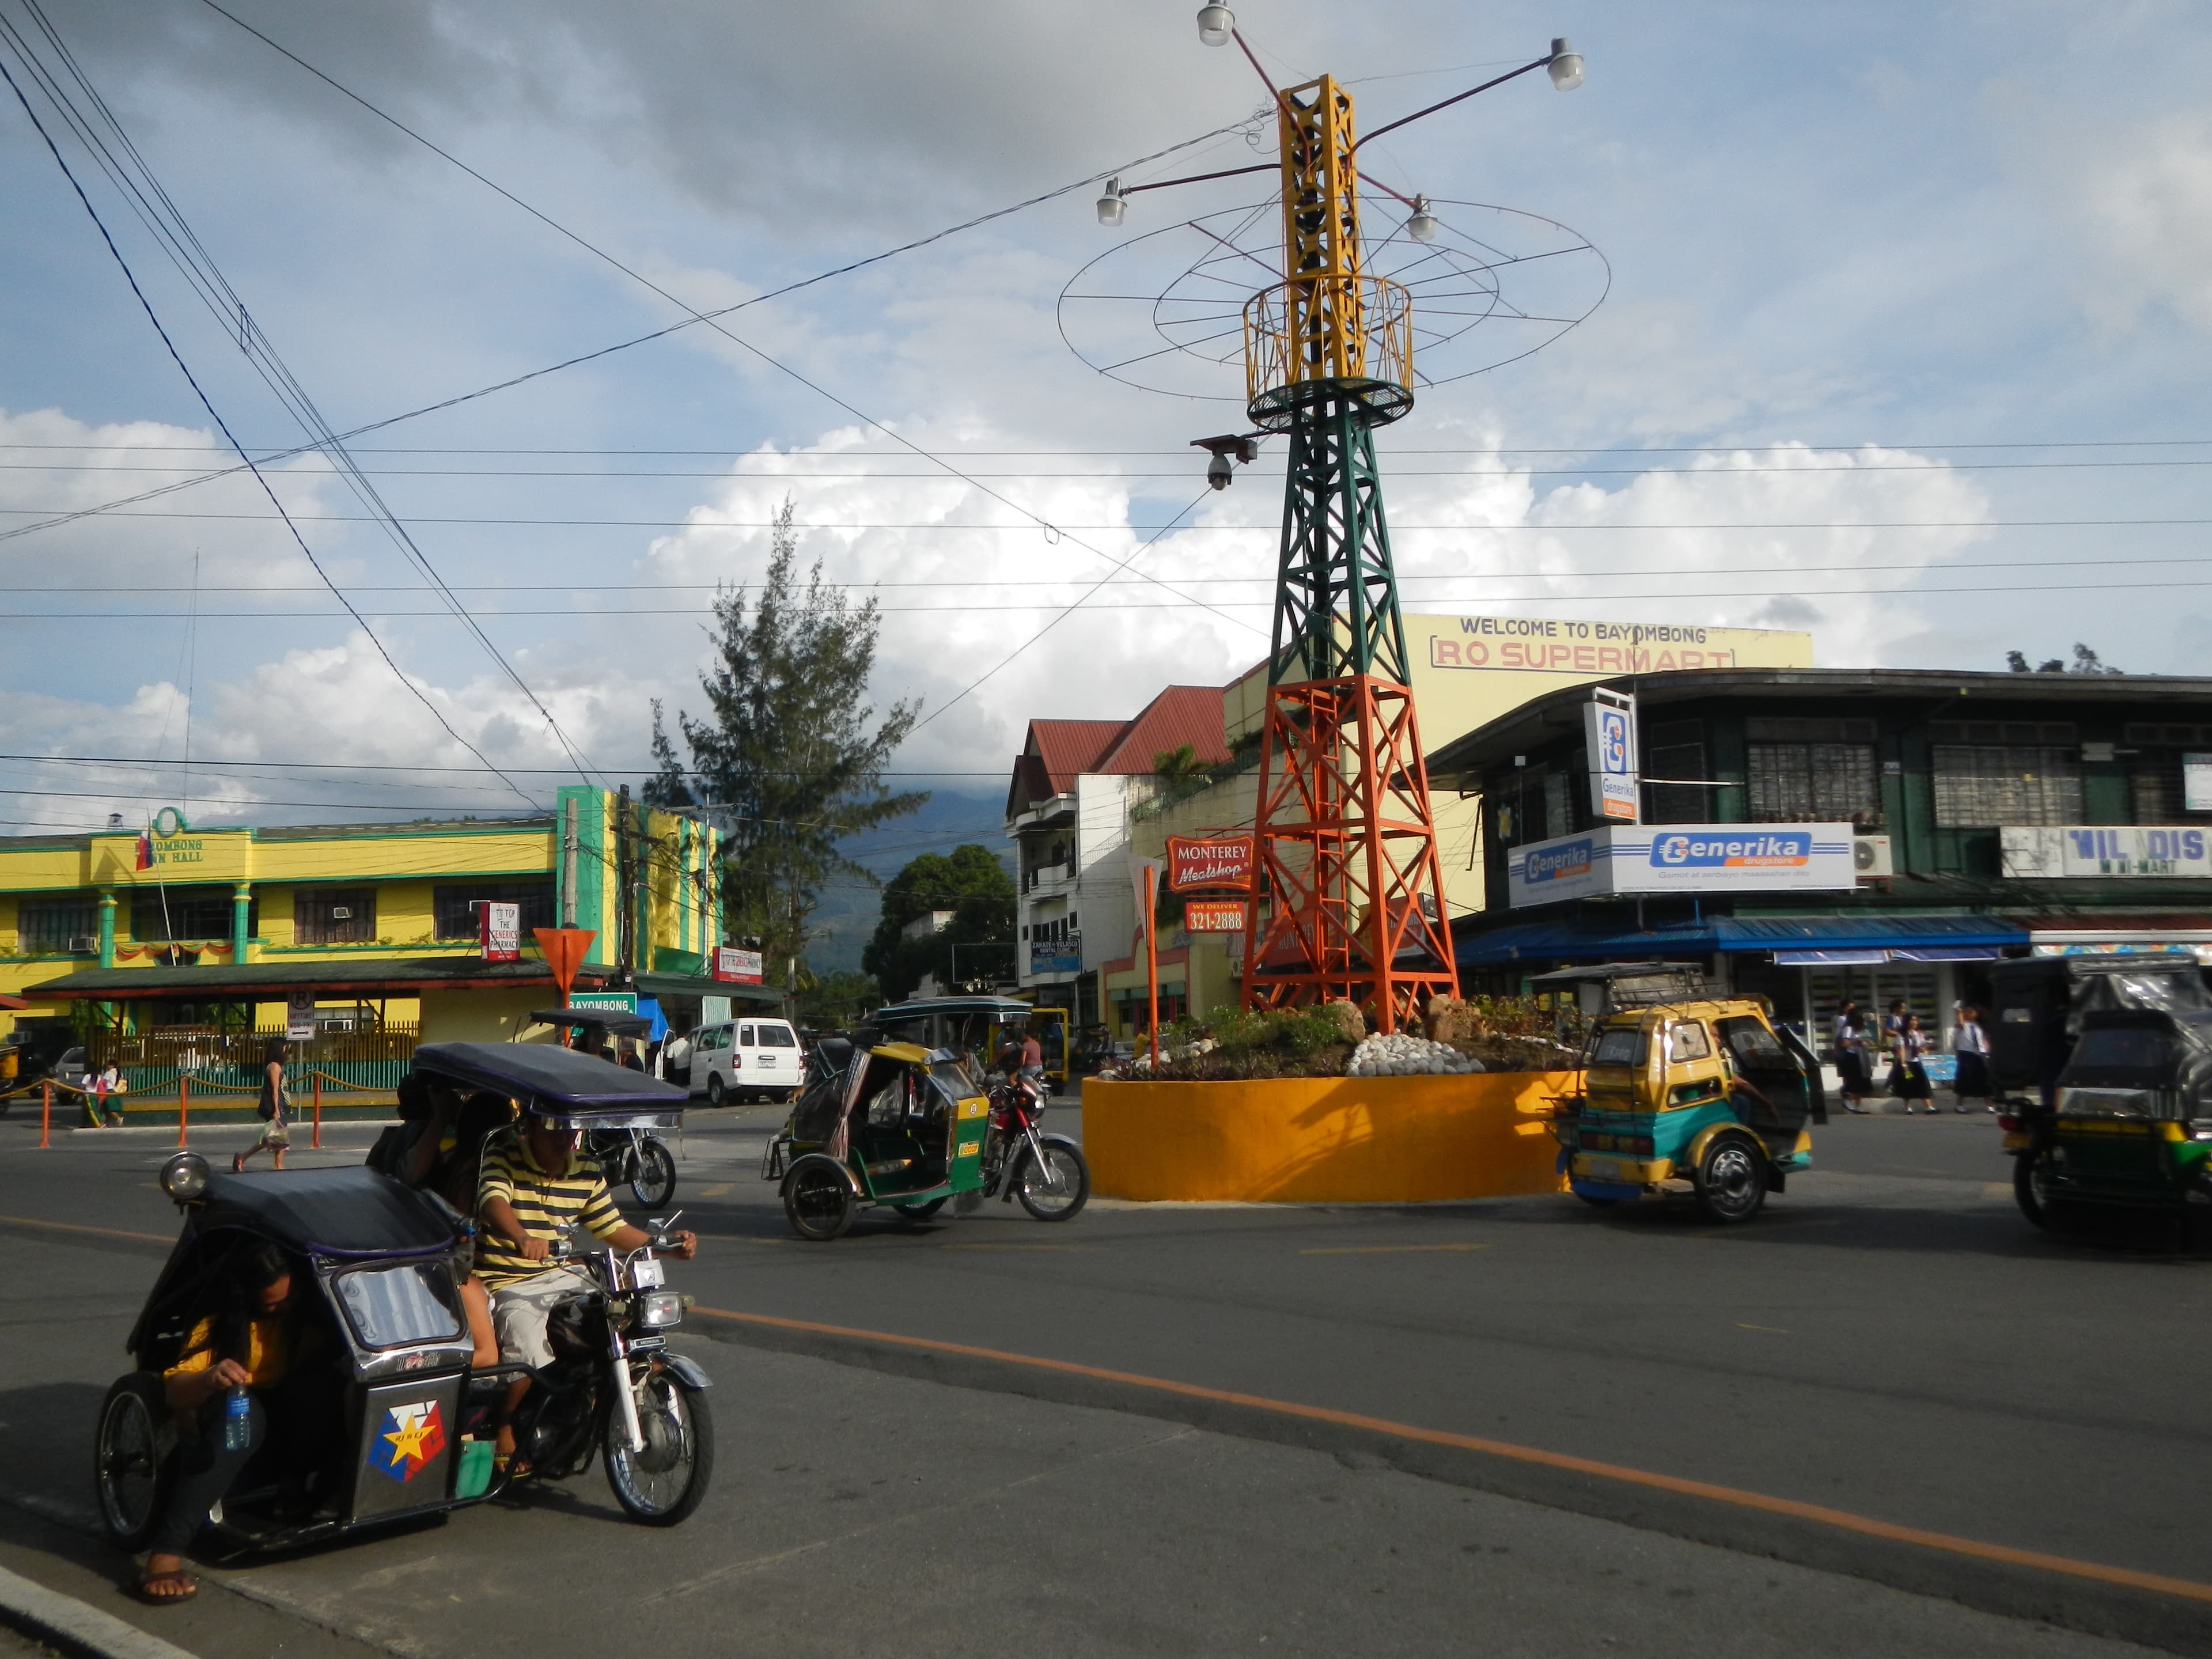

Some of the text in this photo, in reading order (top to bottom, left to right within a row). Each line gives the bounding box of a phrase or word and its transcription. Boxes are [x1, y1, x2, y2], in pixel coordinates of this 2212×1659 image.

[1460, 616, 1706, 643] WELCOME TO BAYOMBONG
[1436, 640, 1730, 672] RO SUPERMART
[1603, 778, 1634, 796] Generika
[1607, 800, 1632, 816] drugstore
[173, 852, 203, 863] HALL
[1178, 846, 1247, 859] MONTEREY
[1658, 837, 1799, 863] Generika
[1528, 847, 1587, 879] Generika
[1744, 858, 1794, 866] drugstore
[1178, 861, 1242, 884] Meatshop
[1190, 912, 1241, 930] 321-2888
[492, 930, 517, 939] GENERICS
[490, 940, 518, 948] PHARMACY
[569, 1000, 628, 1010] BAYOMBONG
